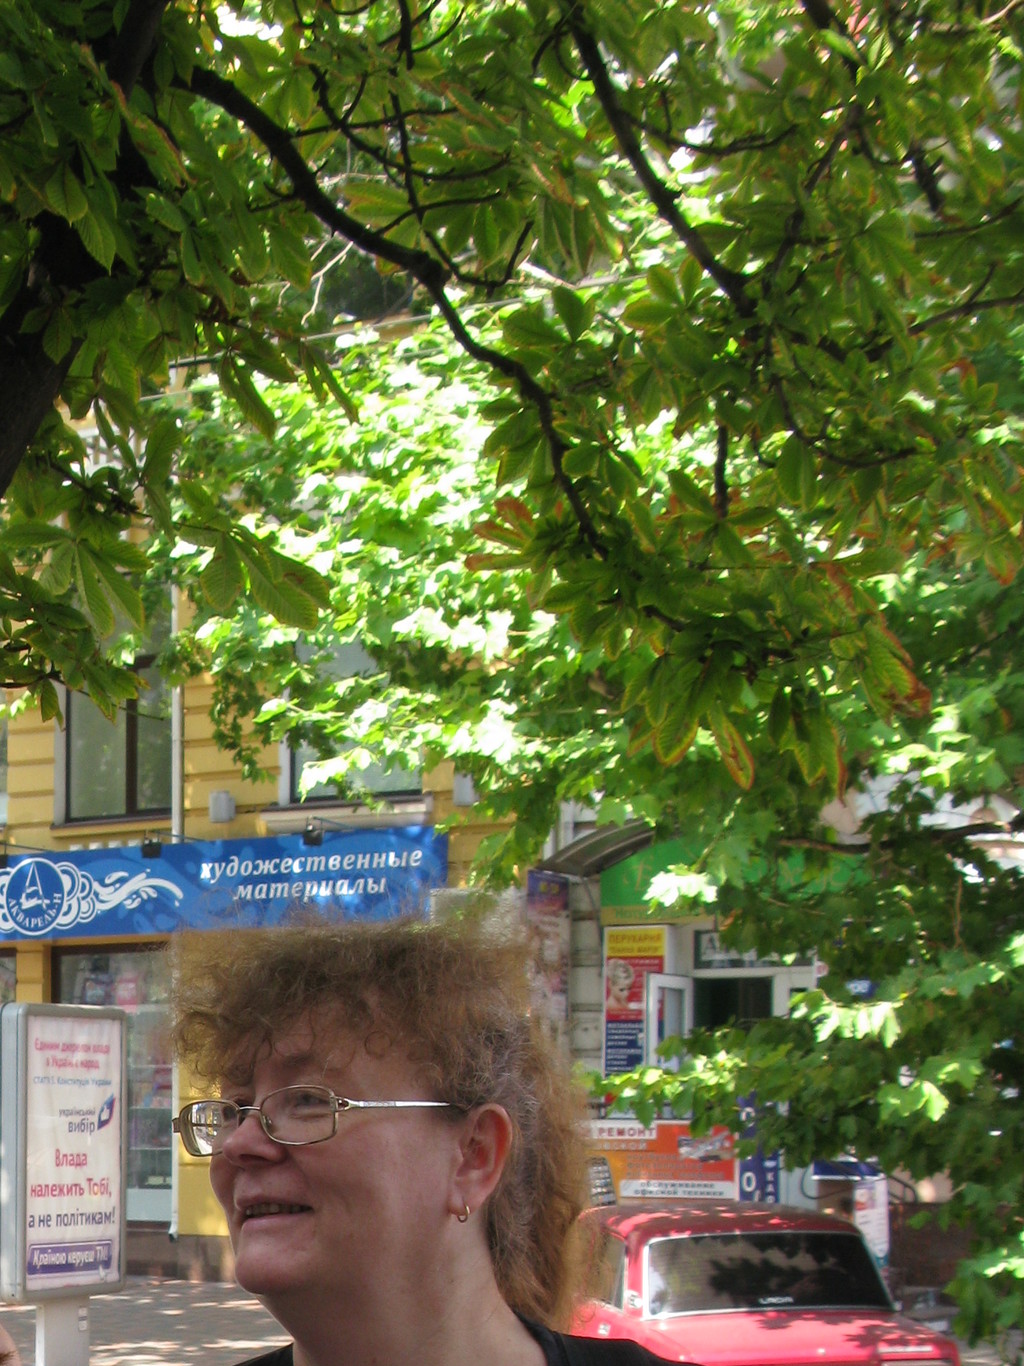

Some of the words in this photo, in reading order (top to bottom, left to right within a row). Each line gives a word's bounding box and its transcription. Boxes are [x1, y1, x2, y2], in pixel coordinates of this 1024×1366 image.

[200, 849, 423, 883] художественные
[233, 876, 387, 902] материалы
[8, 893, 62, 928] АКВАРЕЛЬ-Н
[68, 1117, 95, 1135] вибір
[598, 1127, 656, 1137] РЕМОНТ
[55, 1148, 87, 1168] Влада
[30, 1182, 85, 1198] належить
[86, 1176, 112, 1198] Тобі,
[640, 1180, 715, 1190] обслуживание
[28, 1214, 35, 1228] а
[38, 1213, 52, 1228] не
[55, 1206, 116, 1227] політикам!
[33, 1248, 67, 1268] Країною
